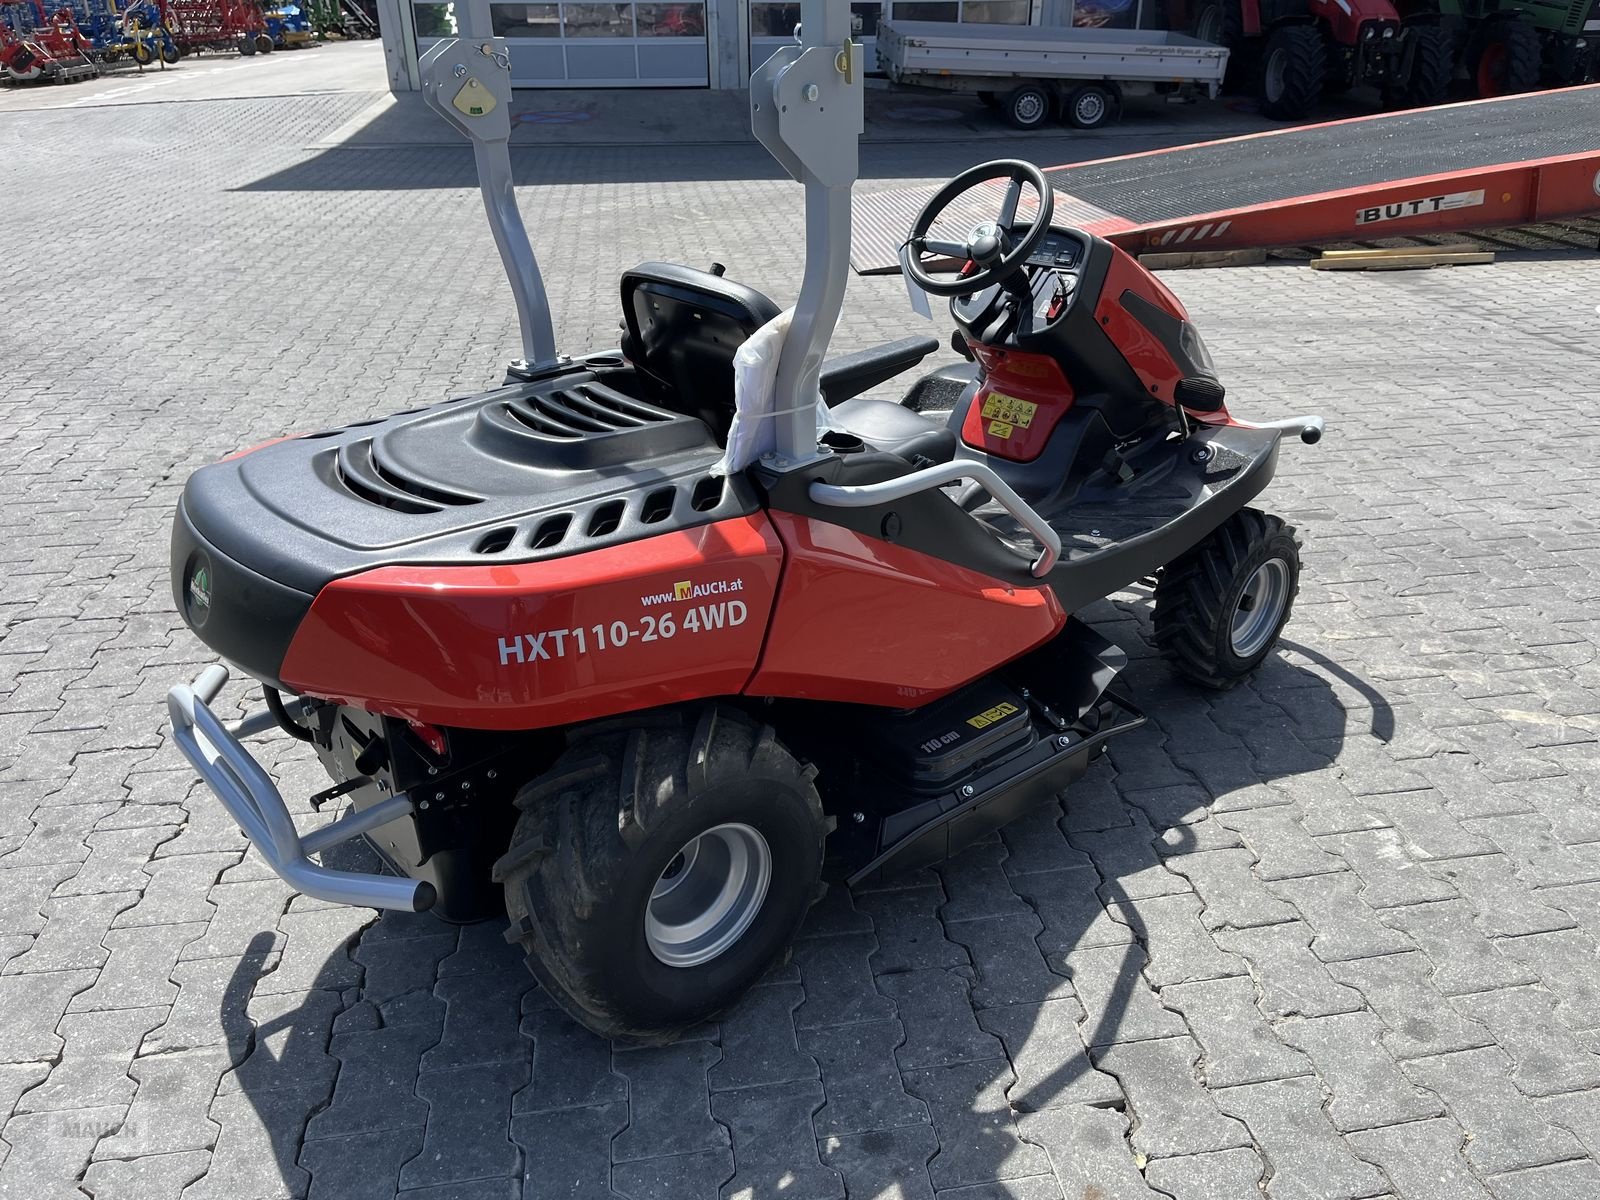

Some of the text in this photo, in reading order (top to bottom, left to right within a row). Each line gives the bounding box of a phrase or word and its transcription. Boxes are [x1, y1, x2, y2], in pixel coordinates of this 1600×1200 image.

[1363, 197, 1445, 223] BUTT
[641, 578, 743, 606] www.MAUCH.at
[497, 600, 748, 665] HXT110-26 4WD
[920, 730, 961, 753] 110 cm
